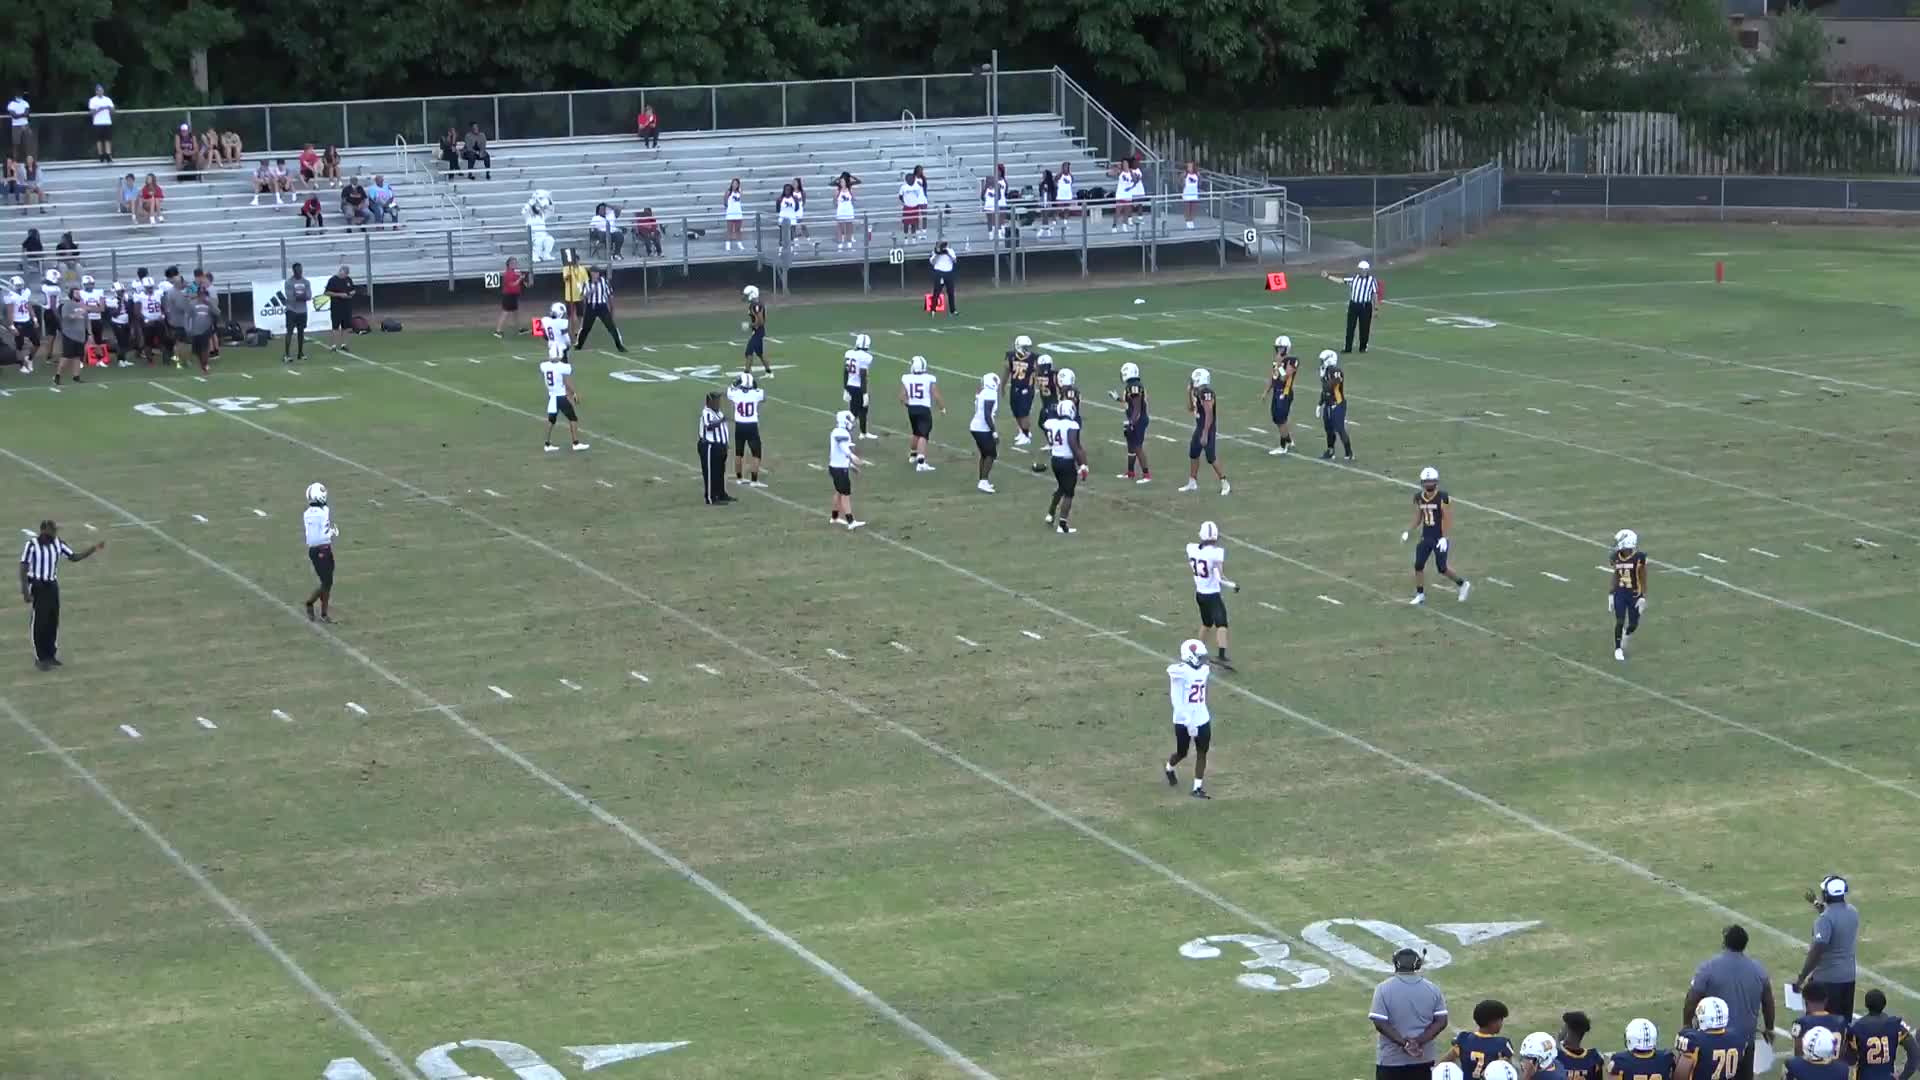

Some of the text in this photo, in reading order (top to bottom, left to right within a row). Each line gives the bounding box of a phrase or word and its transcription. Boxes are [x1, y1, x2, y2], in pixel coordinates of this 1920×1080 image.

[1246, 230, 1255, 242] G
[891, 249, 903, 263] 10
[486, 273, 499, 287] 20
[1274, 274, 1281, 286] G
[260, 307, 287, 317] adid
[909, 383, 924, 399] 15
[736, 402, 755, 417] 40
[1189, 557, 1209, 579] 33
[1179, 918, 1451, 990] 30
[1866, 1036, 1890, 1064] 21
[1470, 1051, 1486, 1078] 7
[1711, 1048, 1738, 1080] 70
